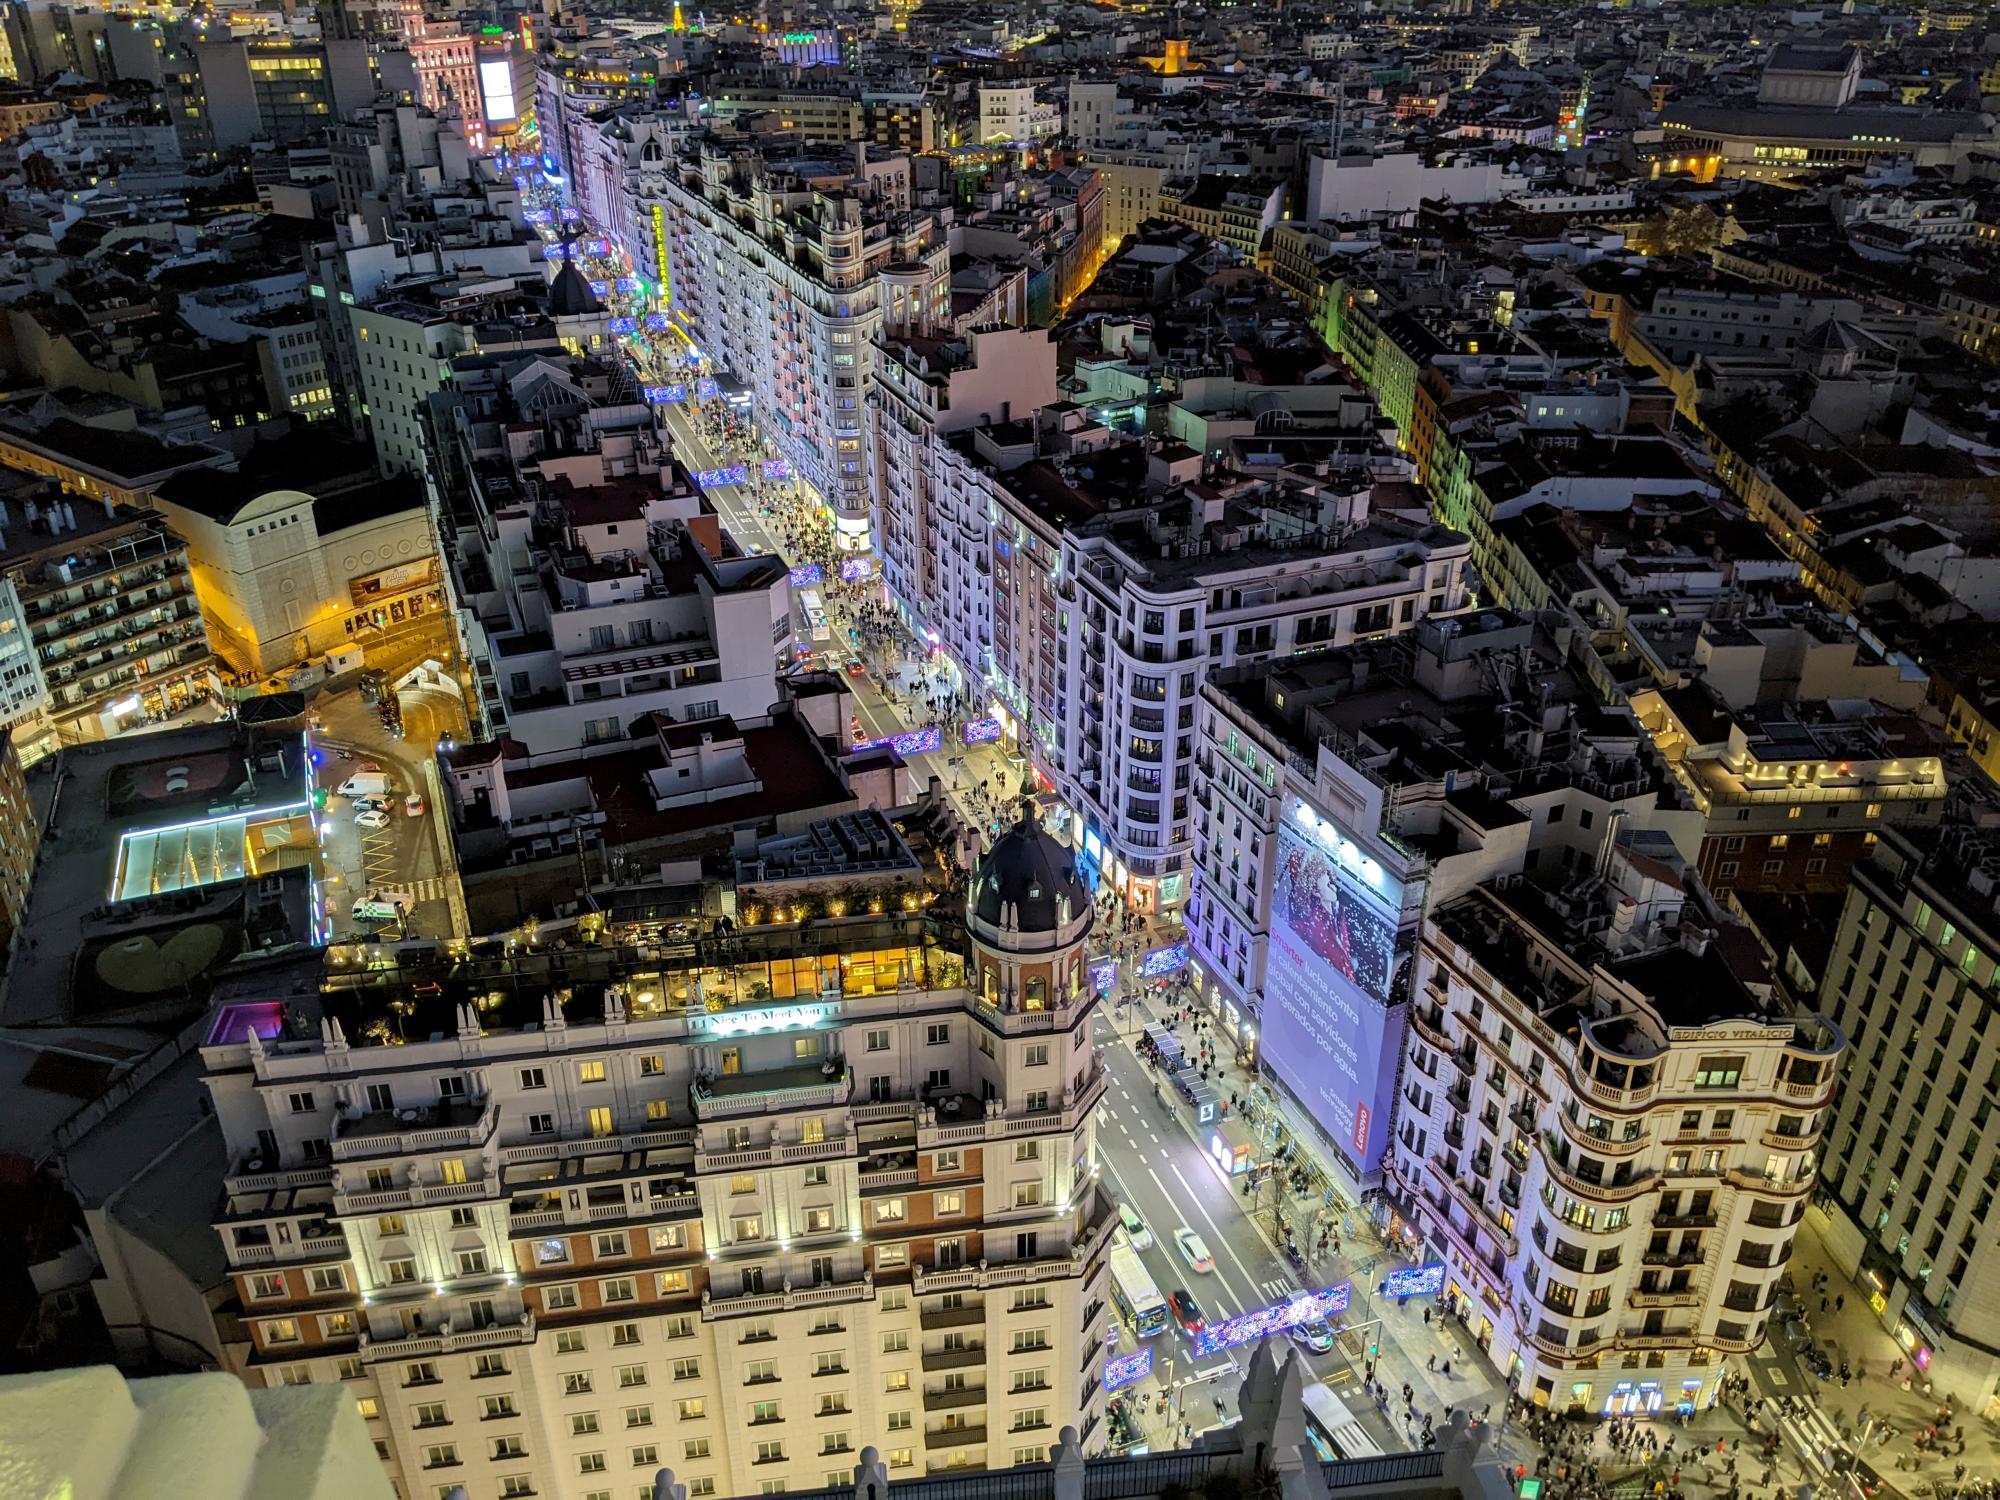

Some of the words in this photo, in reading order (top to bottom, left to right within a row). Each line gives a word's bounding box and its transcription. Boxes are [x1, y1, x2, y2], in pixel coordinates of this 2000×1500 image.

[653, 206, 663, 241] HOTEL
[1278, 955, 1338, 1022] calentamiento
[1304, 959, 1329, 993] lucha
[1329, 988, 1360, 1026] contra
[711, 1016, 737, 1026] Nice
[741, 1013, 757, 1022] To
[761, 1010, 791, 1020] Meet
[797, 1007, 820, 1017] You
[1266, 980, 1316, 1037] refrigerados
[1316, 1030, 1334, 1054] por
[1333, 1050, 1359, 1085] agua.
[1267, 961, 1294, 995] global
[1294, 991, 1311, 1013] con
[1311, 1009, 1359, 1064] servidores
[1675, 1031, 1727, 1039] EDIFICIO
[1732, 1030, 1791, 1038] VITALICIO
[1320, 1086, 1353, 1127] technology
[1356, 1109, 1367, 1150] Lenovo
[1261, 1278, 1292, 1299] TAXI
